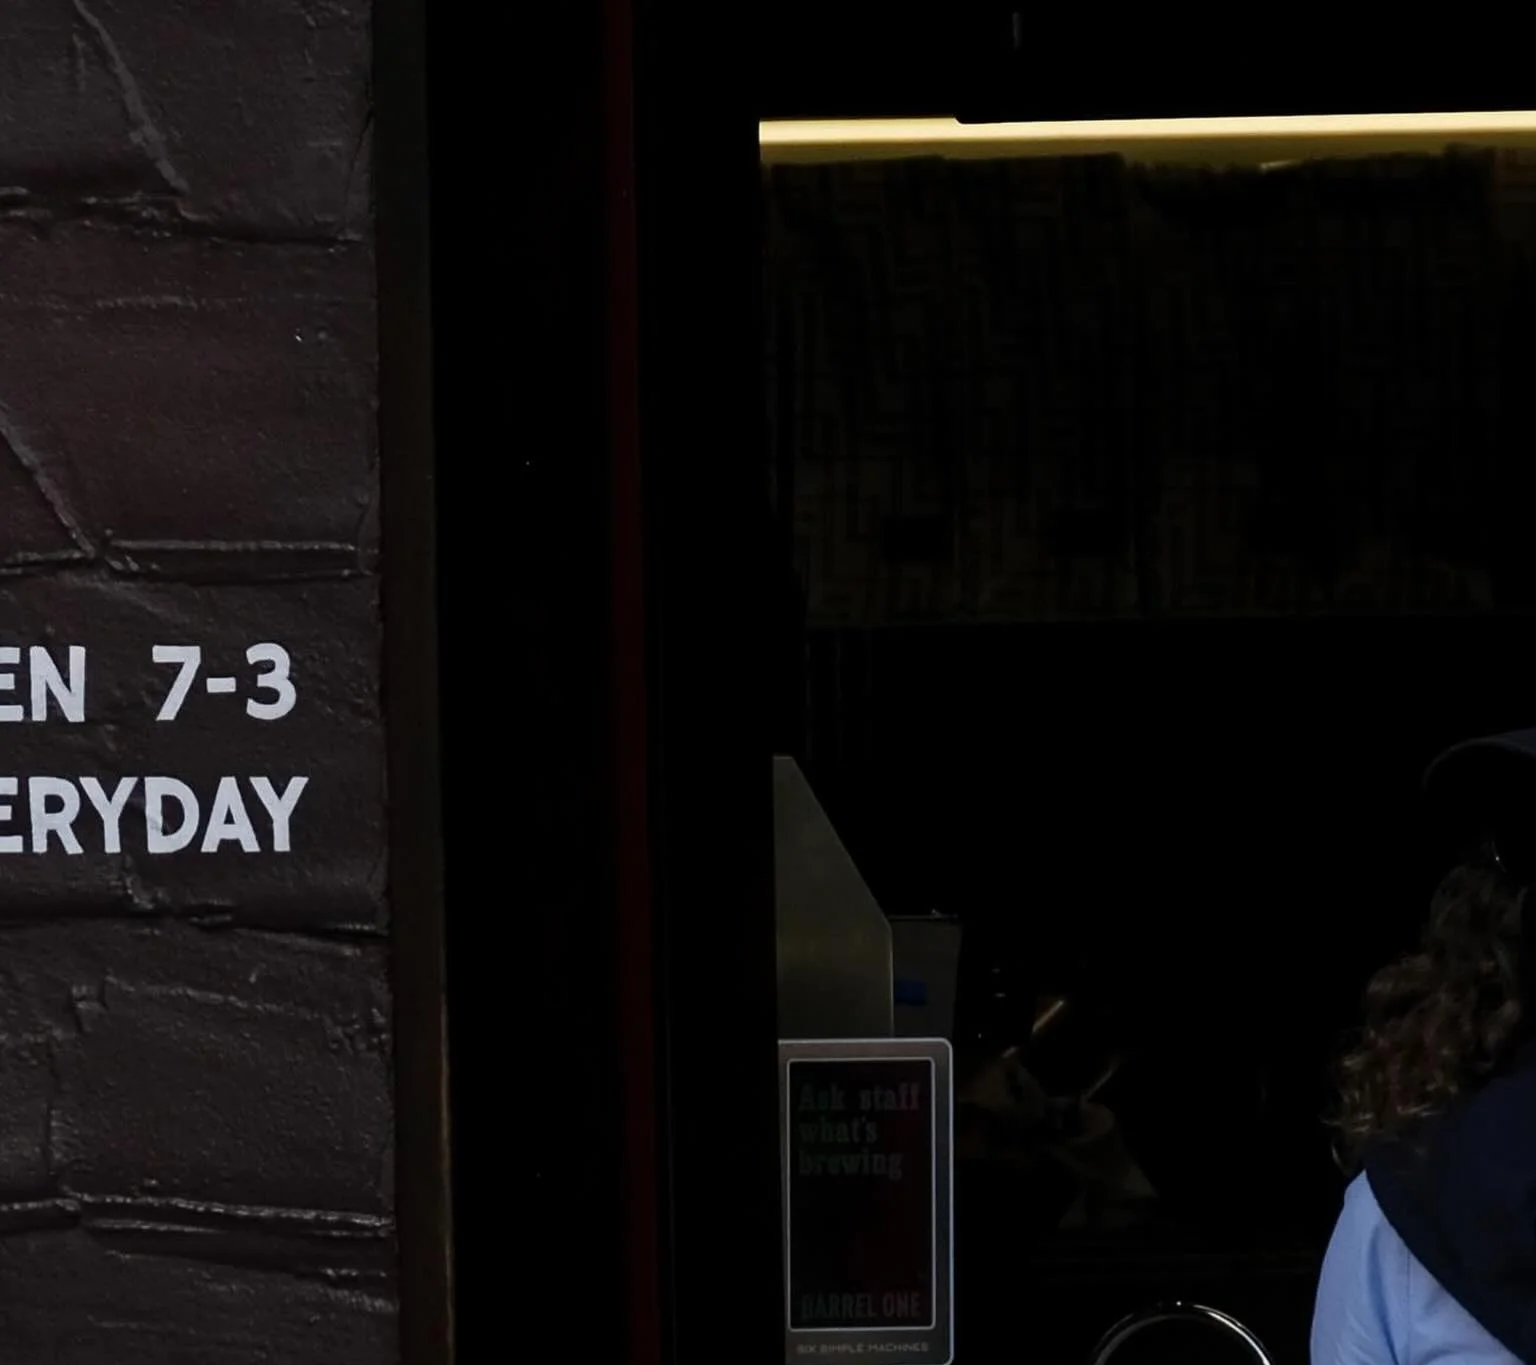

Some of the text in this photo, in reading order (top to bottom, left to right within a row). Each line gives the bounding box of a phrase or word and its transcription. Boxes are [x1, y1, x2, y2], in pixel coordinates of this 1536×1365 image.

[152, 642, 297, 721] 7-3
[798, 1081, 921, 1111] Ask staff
[797, 1114, 879, 1144] what's
[797, 1146, 905, 1184] brewing
[801, 1290, 922, 1321] BARREL ONE
